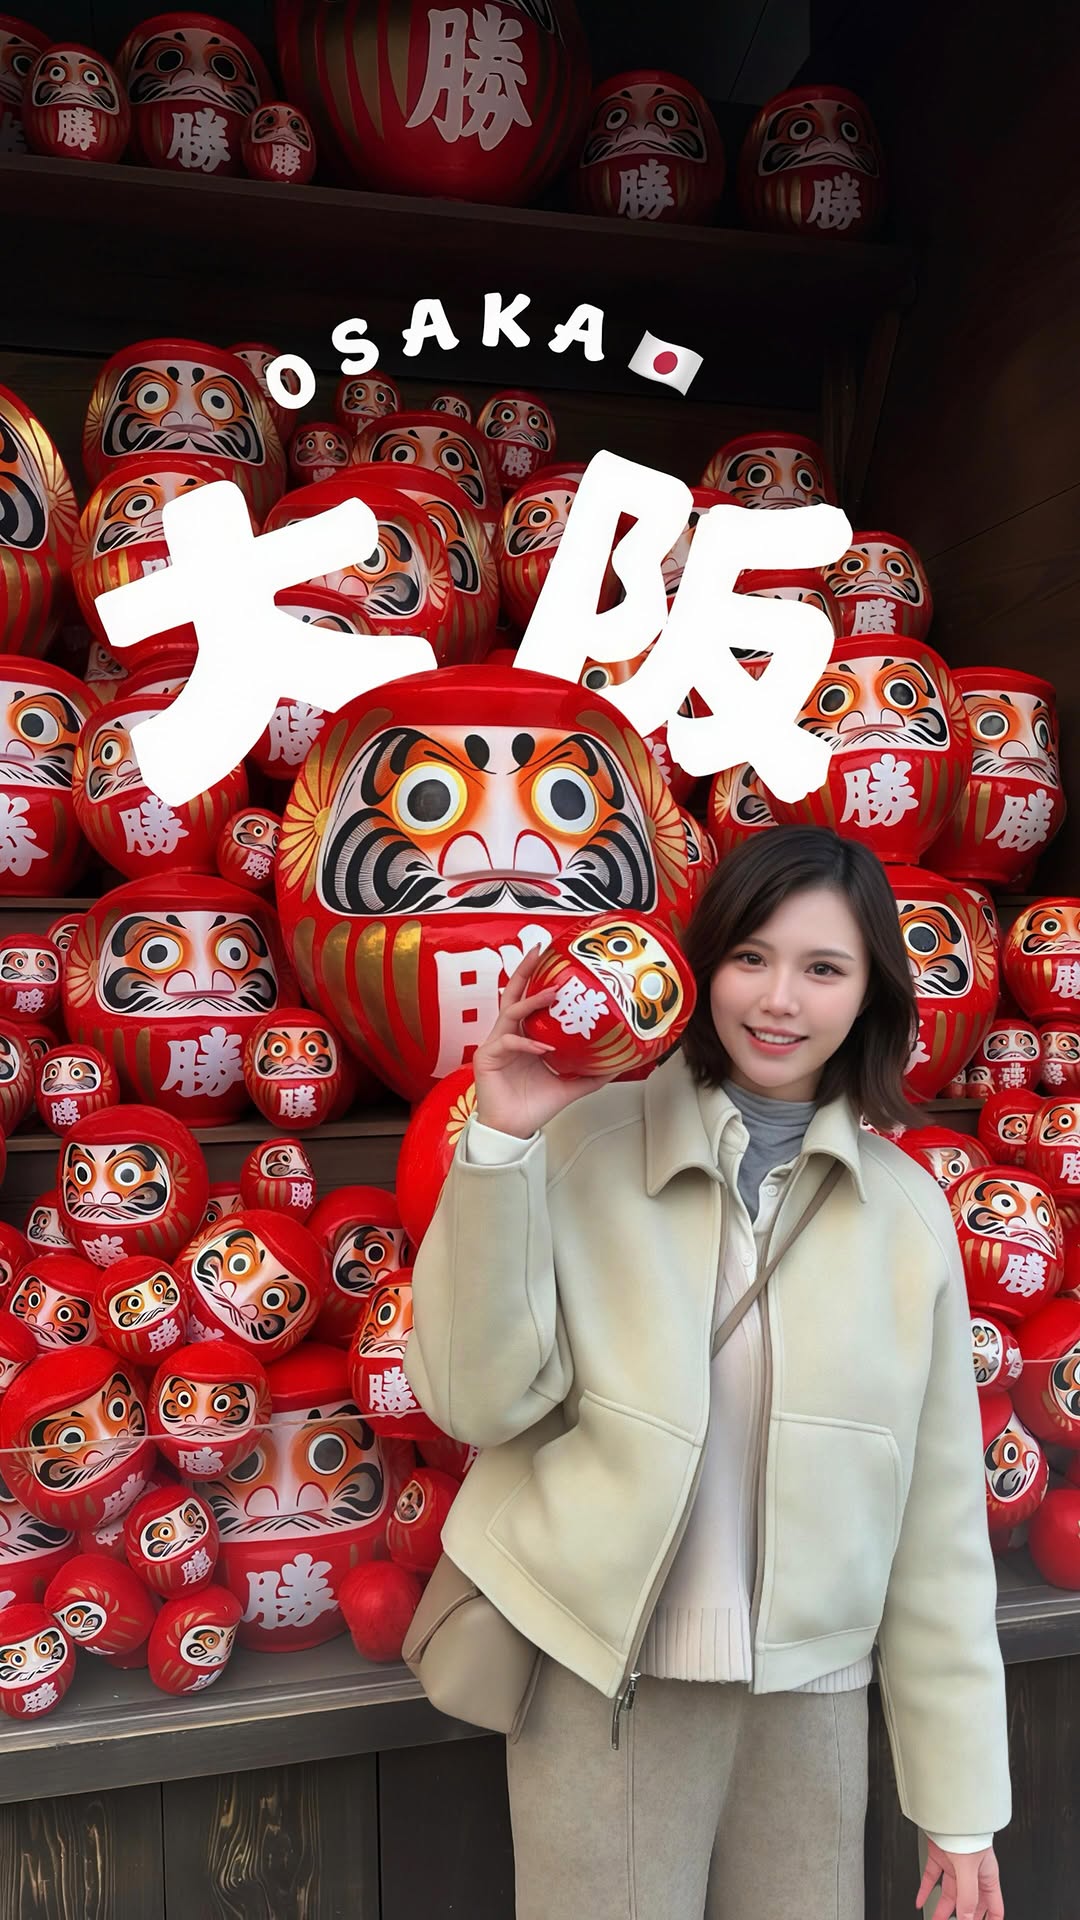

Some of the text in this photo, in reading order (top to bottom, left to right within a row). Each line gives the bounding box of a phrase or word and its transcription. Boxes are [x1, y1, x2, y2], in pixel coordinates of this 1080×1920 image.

[405, 3, 533, 151] 勝
[56, 107, 98, 151] 勝
[166, 107, 232, 174] 勝
[270, 143, 301, 176] 勝
[617, 158, 675, 220] 勝
[806, 171, 862, 231] 勝
[841, 753, 919, 828] 勝
[985, 788, 1054, 852] 勝
[119, 795, 190, 856] 勝
[550, 976, 609, 1039] 勝
[161, 1026, 243, 1098] 勝
[279, 1085, 317, 1119] 勝
[998, 1251, 1048, 1297] 勝
[368, 1366, 417, 1414] 勝
[243, 1552, 338, 1630] 勝
